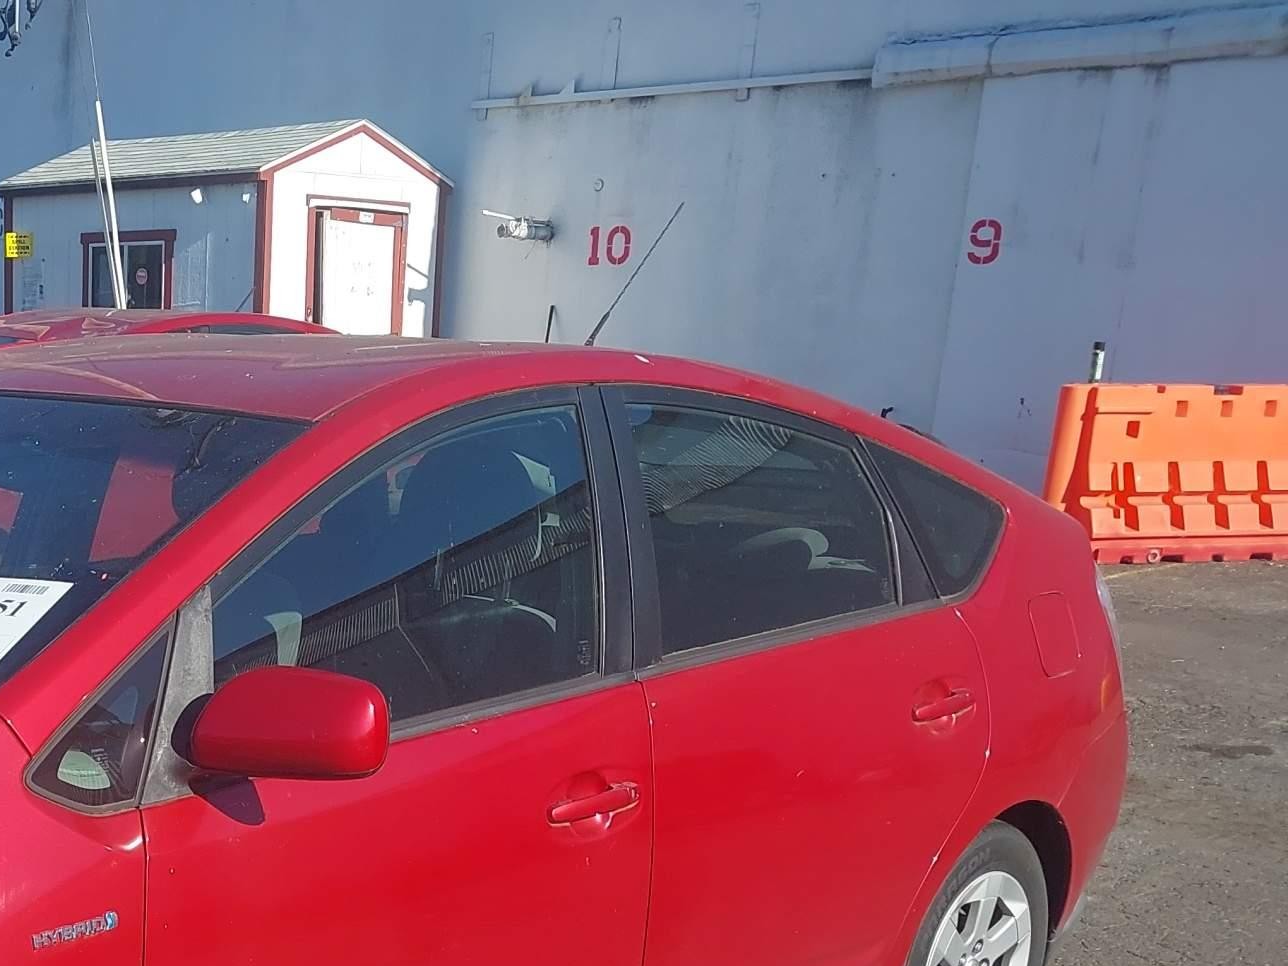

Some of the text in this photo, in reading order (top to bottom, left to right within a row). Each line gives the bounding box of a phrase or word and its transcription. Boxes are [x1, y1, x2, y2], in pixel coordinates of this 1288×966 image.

[588, 225, 631, 266] 10
[967, 219, 1002, 264] 9
[32, 917, 105, 951] HYBRID
